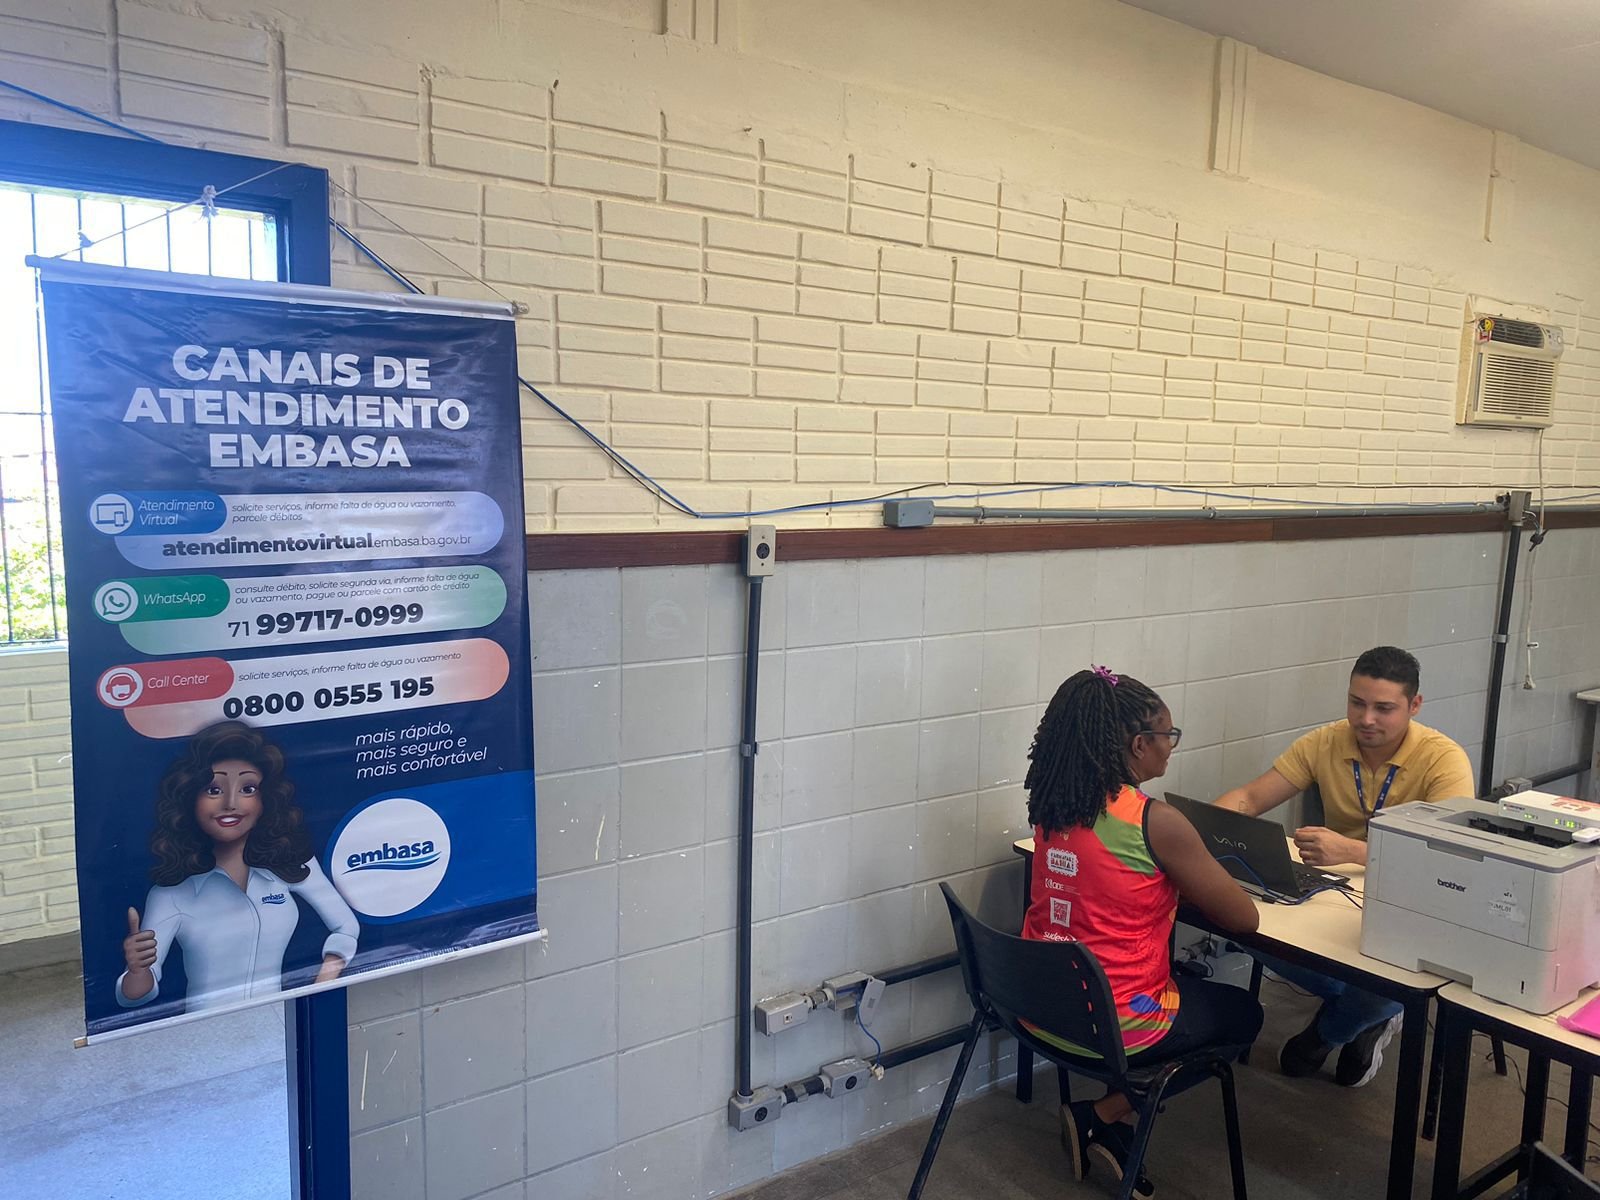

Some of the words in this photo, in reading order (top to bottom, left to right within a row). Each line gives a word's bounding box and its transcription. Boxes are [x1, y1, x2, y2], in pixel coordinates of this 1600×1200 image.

[172, 344, 361, 388] CANAIS
[373, 355, 432, 390] DE
[122, 387, 470, 430] ATENDIMENTO
[209, 433, 412, 468] EMBASA
[138, 499, 215, 511] Atendimento
[231, 503, 264, 512] solicite
[265, 503, 303, 512] serviços,
[304, 501, 339, 510] informe
[340, 500, 360, 510] falta
[361, 500, 373, 509] de
[374, 500, 397, 510] água
[410, 500, 456, 509] vazamento,
[139, 513, 179, 525] Virtual
[231, 513, 268, 524] parcele
[269, 512, 303, 521] débitos
[235, 584, 274, 594] consulte
[276, 583, 307, 592] débito,
[309, 581, 338, 589] solicite
[340, 578, 377, 590] segunda
[394, 575, 425, 584] informe
[426, 574, 445, 582] falta
[445, 573, 457, 581] de
[458, 573, 480, 582] água
[235, 597, 248, 605] ou
[250, 594, 304, 603] vazamento,
[306, 591, 336, 600] pague
[350, 588, 381, 598] parcele
[403, 584, 430, 593] cartão
[431, 583, 442, 591] de
[443, 582, 470, 591] crédito
[143, 592, 206, 606] WhatsApp
[228, 621, 250, 637] 71
[256, 602, 424, 636] 99717-0999
[238, 671, 270, 681] solicite
[271, 668, 310, 679] serviços,
[311, 664, 346, 674] informe
[347, 662, 366, 671] falta
[367, 660, 379, 668] de
[380, 659, 403, 669] água
[404, 657, 415, 665] ou
[417, 652, 462, 663] vazamento
[147, 676, 170, 689] Call
[171, 674, 210, 687] Center
[223, 691, 305, 719] 0800
[314, 682, 383, 709] 0555
[390, 676, 435, 699] 195
[355, 728, 396, 746] mais
[400, 721, 453, 741] rápido,
[356, 745, 397, 763] mais
[400, 739, 454, 757] seguro
[457, 737, 467, 747] e
[357, 761, 397, 780] mais
[401, 746, 488, 773] confortável
[347, 840, 434, 868] embasa
[1212, 834, 1248, 851] VAIO
[1437, 878, 1468, 893] brother
[261, 893, 285, 903] embasa
